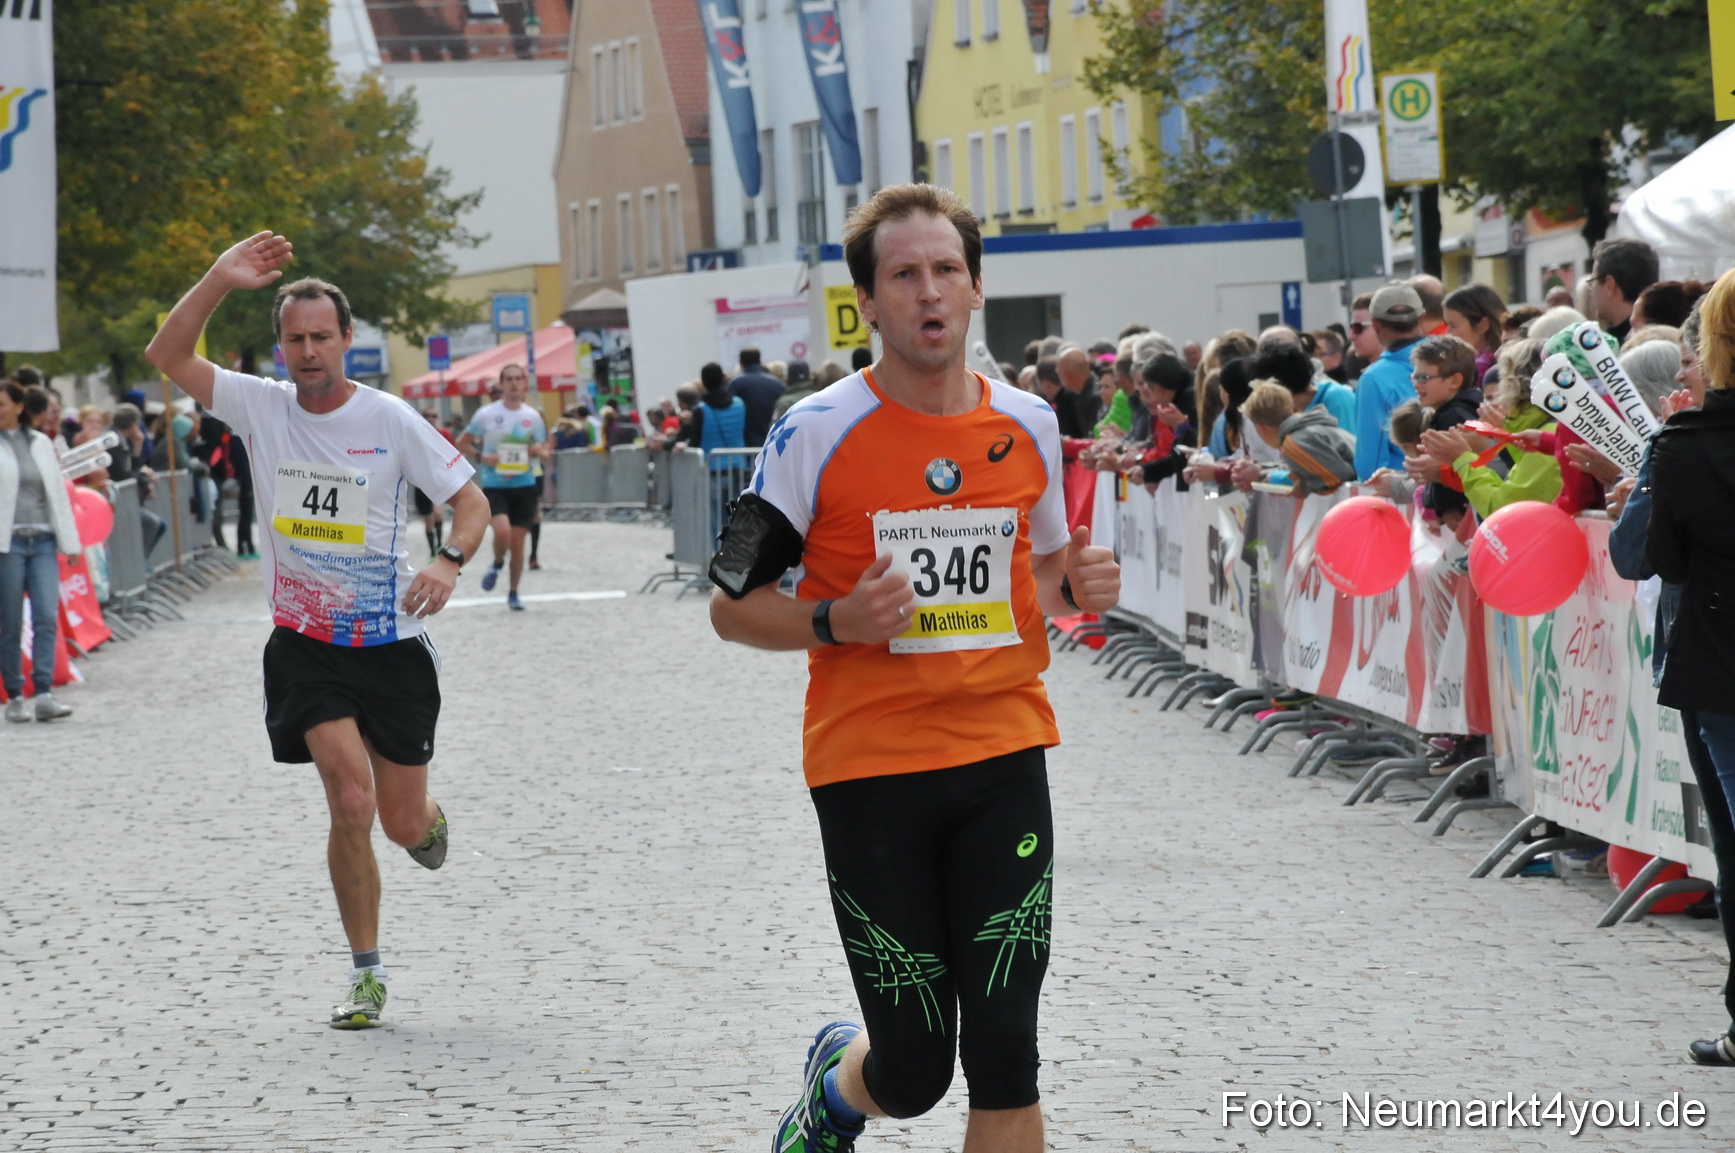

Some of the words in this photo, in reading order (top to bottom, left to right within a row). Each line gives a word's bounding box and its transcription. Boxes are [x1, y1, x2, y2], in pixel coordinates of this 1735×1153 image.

[1400, 88, 1421, 112] H
[837, 304, 859, 335] D
[1596, 356, 1635, 403] BMW
[1625, 403, 1652, 442] Lau
[278, 468, 307, 479] PARTL
[310, 471, 352, 484] Neumarkt
[302, 485, 339, 518] 44
[291, 523, 344, 541] Matthias
[879, 527, 928, 541] PARTL
[931, 523, 997, 539] Neumarkt
[910, 544, 992, 598] 346
[919, 611, 988, 633] Matthias
